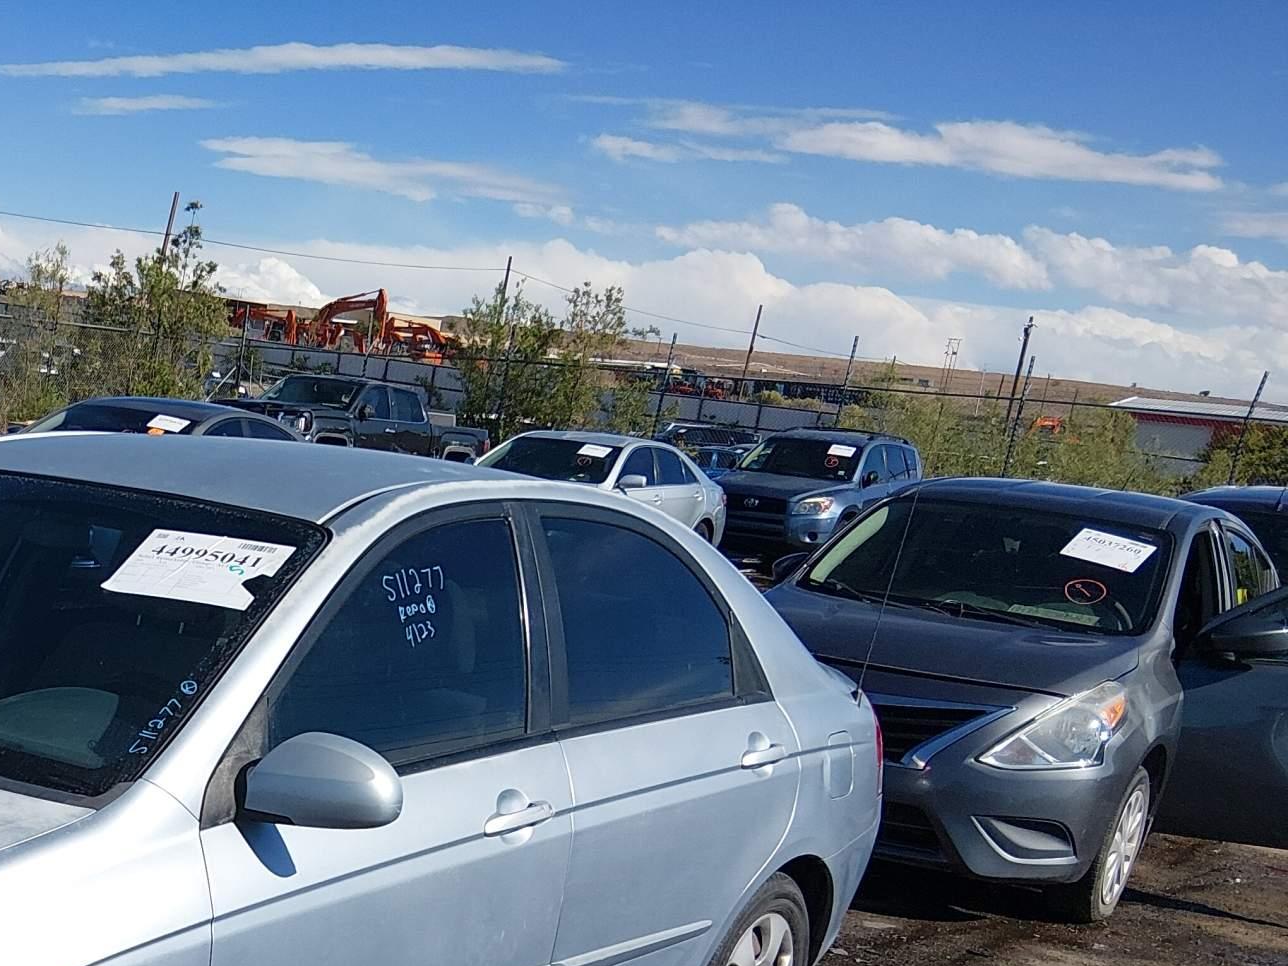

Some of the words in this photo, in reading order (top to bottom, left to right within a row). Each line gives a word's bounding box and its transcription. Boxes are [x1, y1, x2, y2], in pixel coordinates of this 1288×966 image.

[151, 544, 264, 568] 44995041
[382, 565, 444, 601] 511277
[128, 698, 182, 754] 511277
